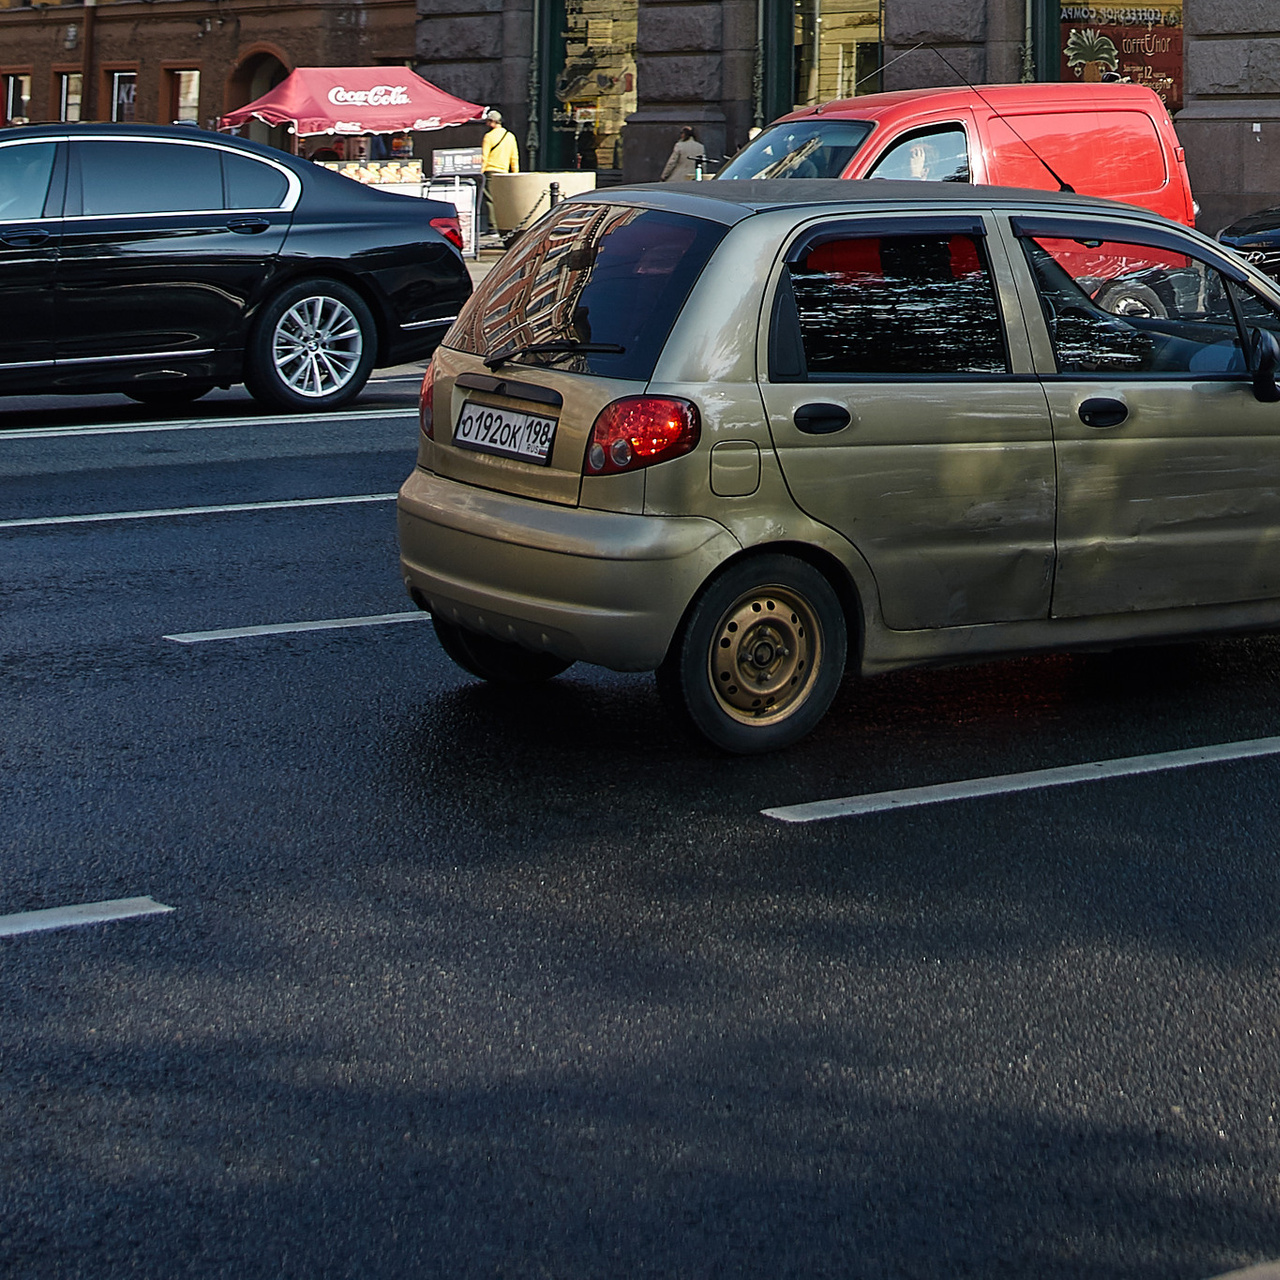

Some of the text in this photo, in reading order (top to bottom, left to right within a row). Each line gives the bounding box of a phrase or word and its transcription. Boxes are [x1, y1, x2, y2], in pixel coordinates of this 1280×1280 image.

[1144, 65, 1153, 79] 12
[328, 85, 412, 107] Coca-Cola
[462, 411, 551, 449] О192ОК 198
[526, 443, 540, 454] RUS
